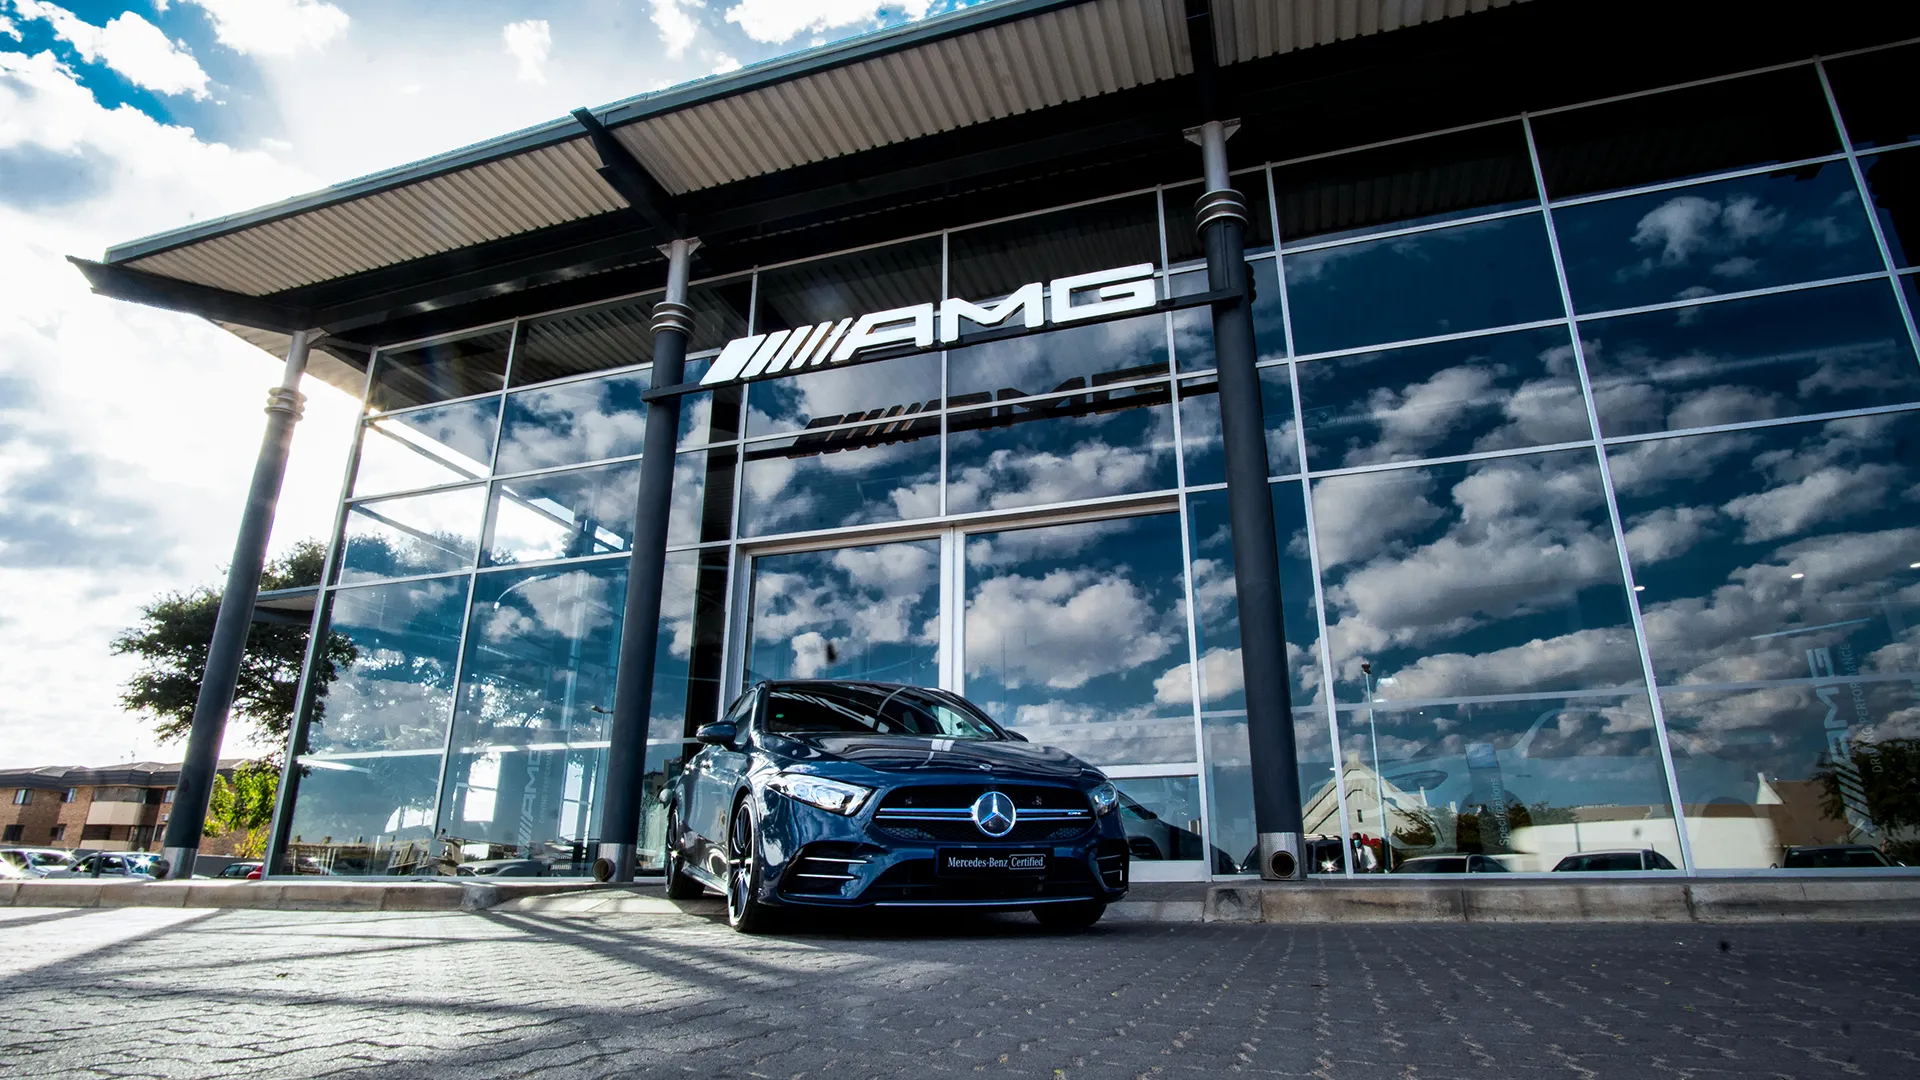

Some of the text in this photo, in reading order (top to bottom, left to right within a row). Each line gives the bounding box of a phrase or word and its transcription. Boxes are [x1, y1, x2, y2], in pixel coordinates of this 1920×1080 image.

[831, 263, 1156, 362] AMG
[948, 856, 1044, 868] Mercedes-Benz Certified
